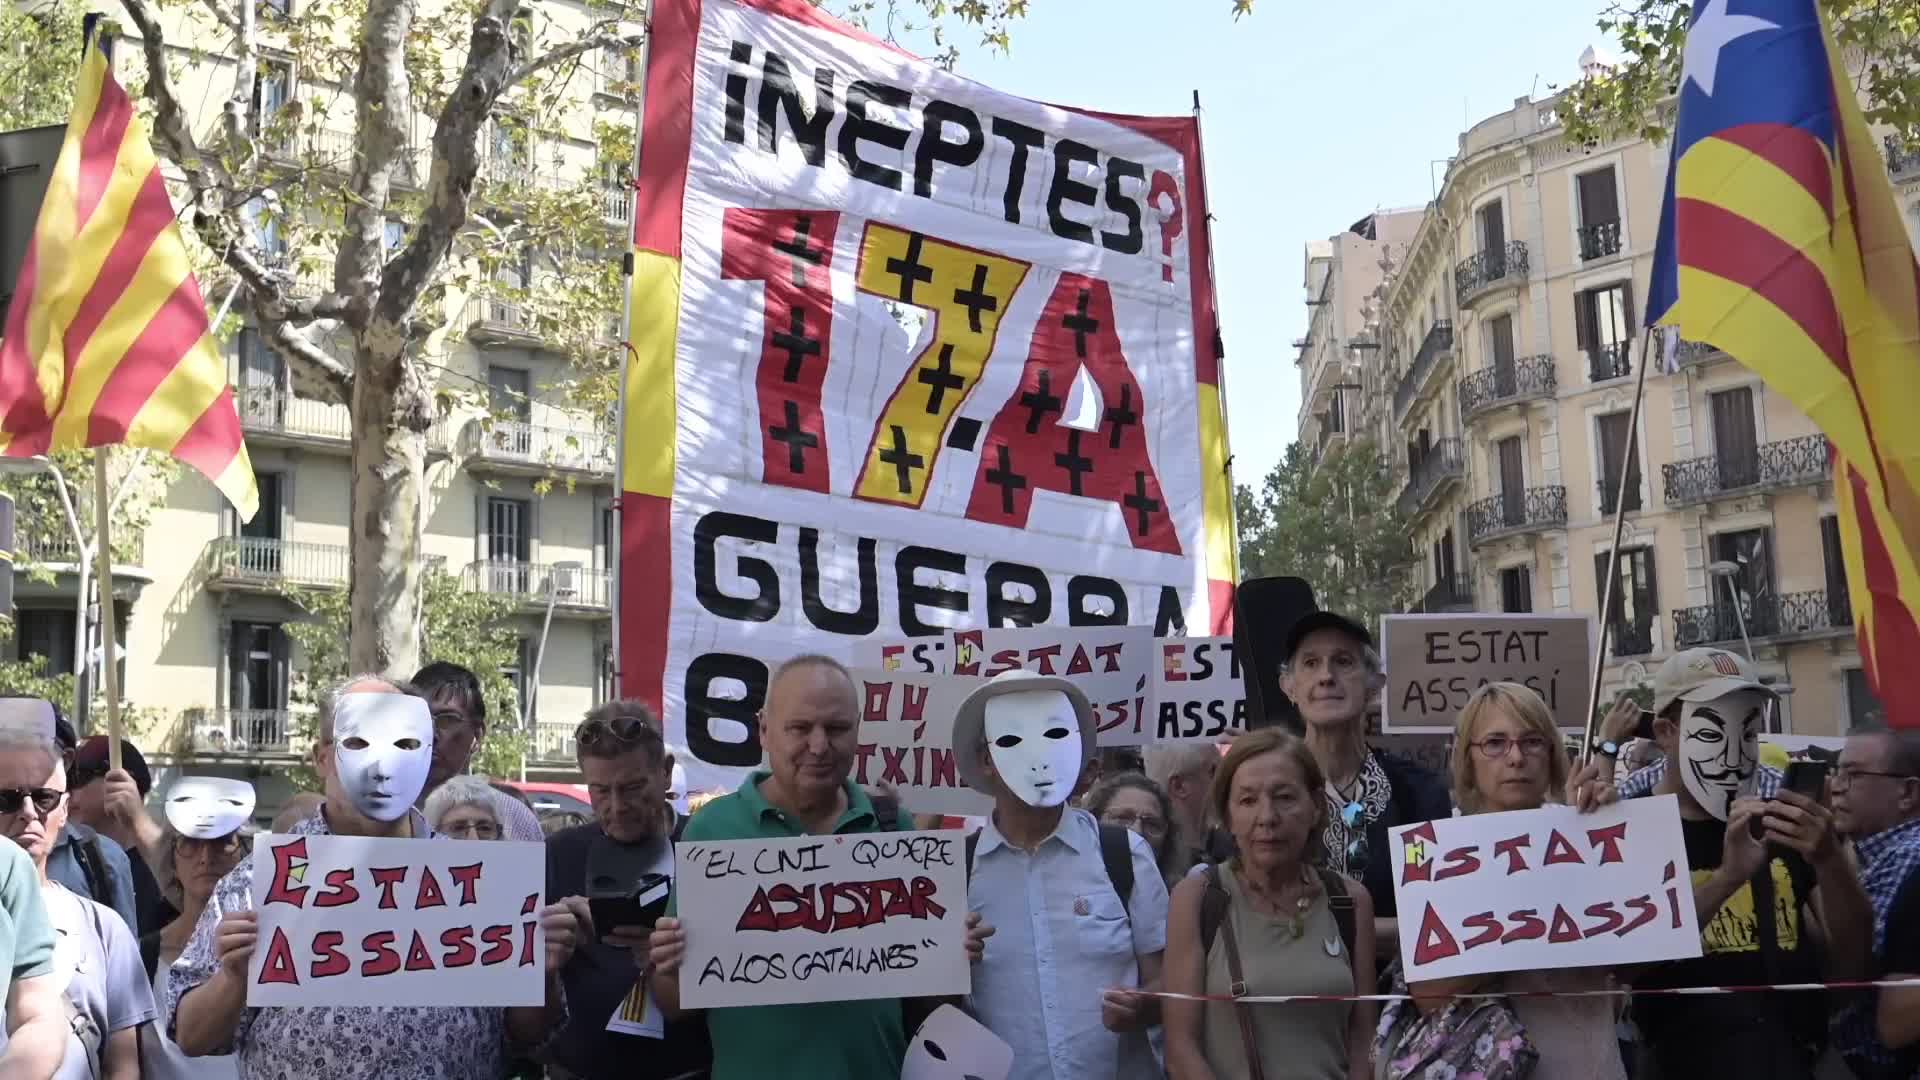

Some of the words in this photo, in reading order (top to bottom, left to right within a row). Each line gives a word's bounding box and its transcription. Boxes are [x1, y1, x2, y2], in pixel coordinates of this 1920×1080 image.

[954, 630, 1125, 677] ESTAT
[1425, 630, 1548, 664] ESTAT
[263, 836, 483, 909] ESTAT
[1401, 820, 1628, 887] ESTAT
[736, 876, 947, 934] ASUSTAR
[699, 956, 725, 986] A
[729, 953, 787, 984] LOS
